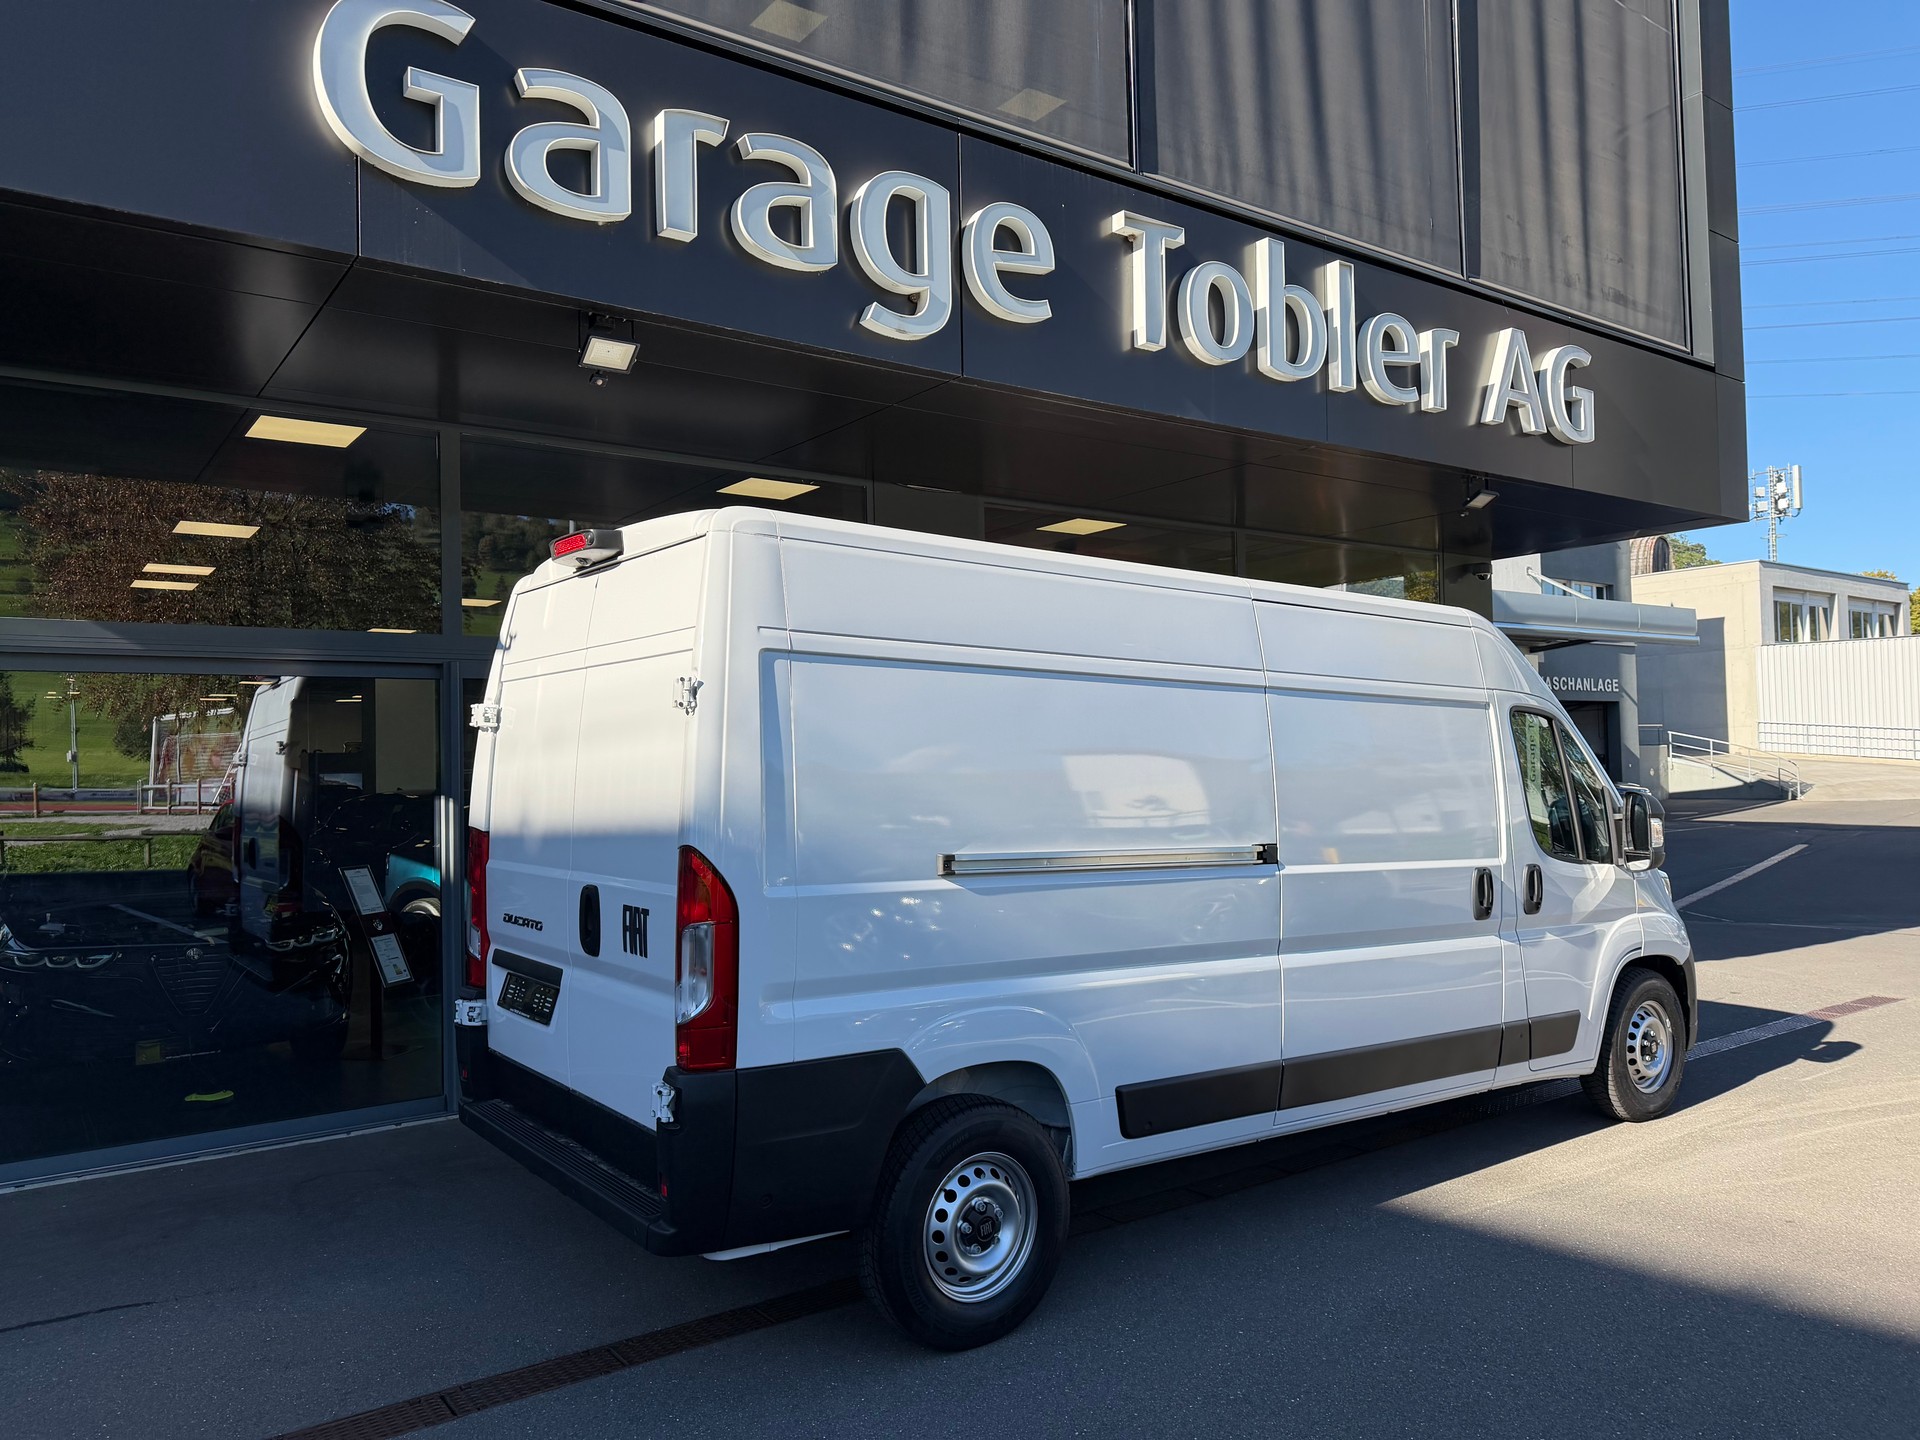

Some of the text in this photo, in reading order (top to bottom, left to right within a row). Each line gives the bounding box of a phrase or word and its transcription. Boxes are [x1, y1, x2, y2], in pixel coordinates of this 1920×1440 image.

[312, 0, 1595, 445] Garage Tobler AG
[1542, 676, 1620, 692] ASCHANLAGE
[502, 912, 544, 932] DUCATO
[622, 904, 650, 959] FIAT
[979, 1220, 993, 1238] FIAT
